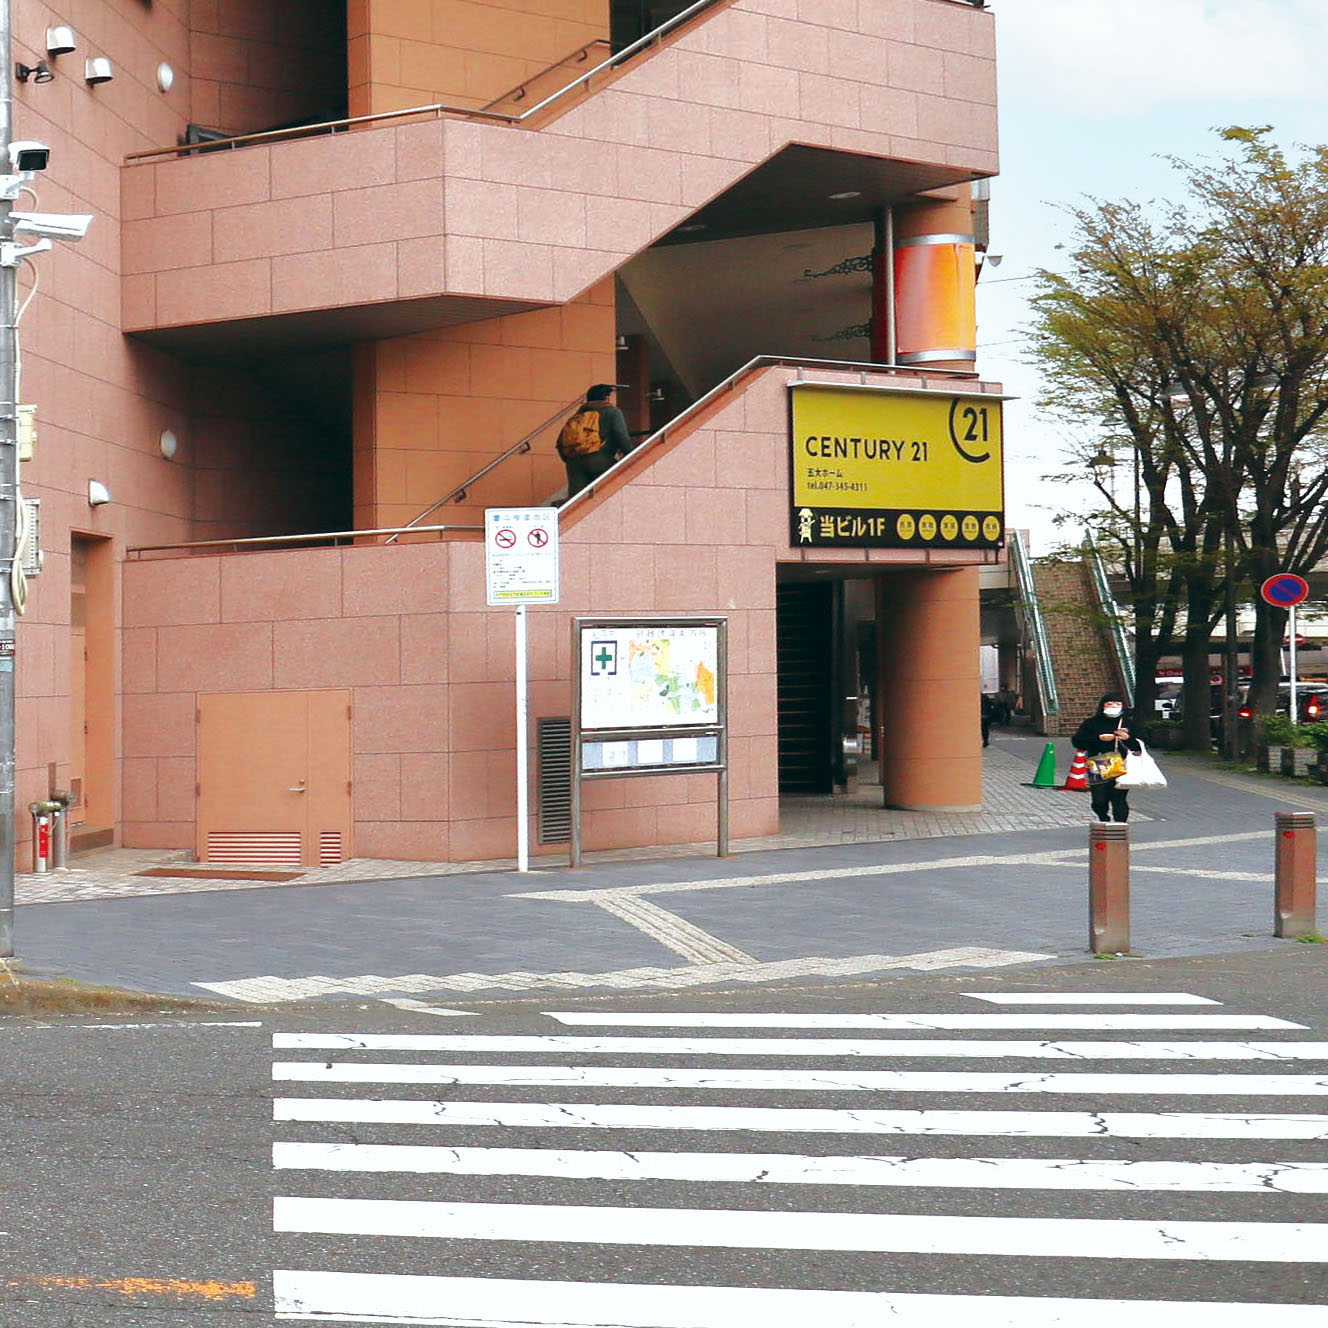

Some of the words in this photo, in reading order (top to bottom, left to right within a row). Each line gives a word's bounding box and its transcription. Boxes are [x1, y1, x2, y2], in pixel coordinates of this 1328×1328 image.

[805, 436, 905, 461] CENTURY
[911, 441, 928, 462] 21
[819, 514, 886, 538] 当ビル1F
